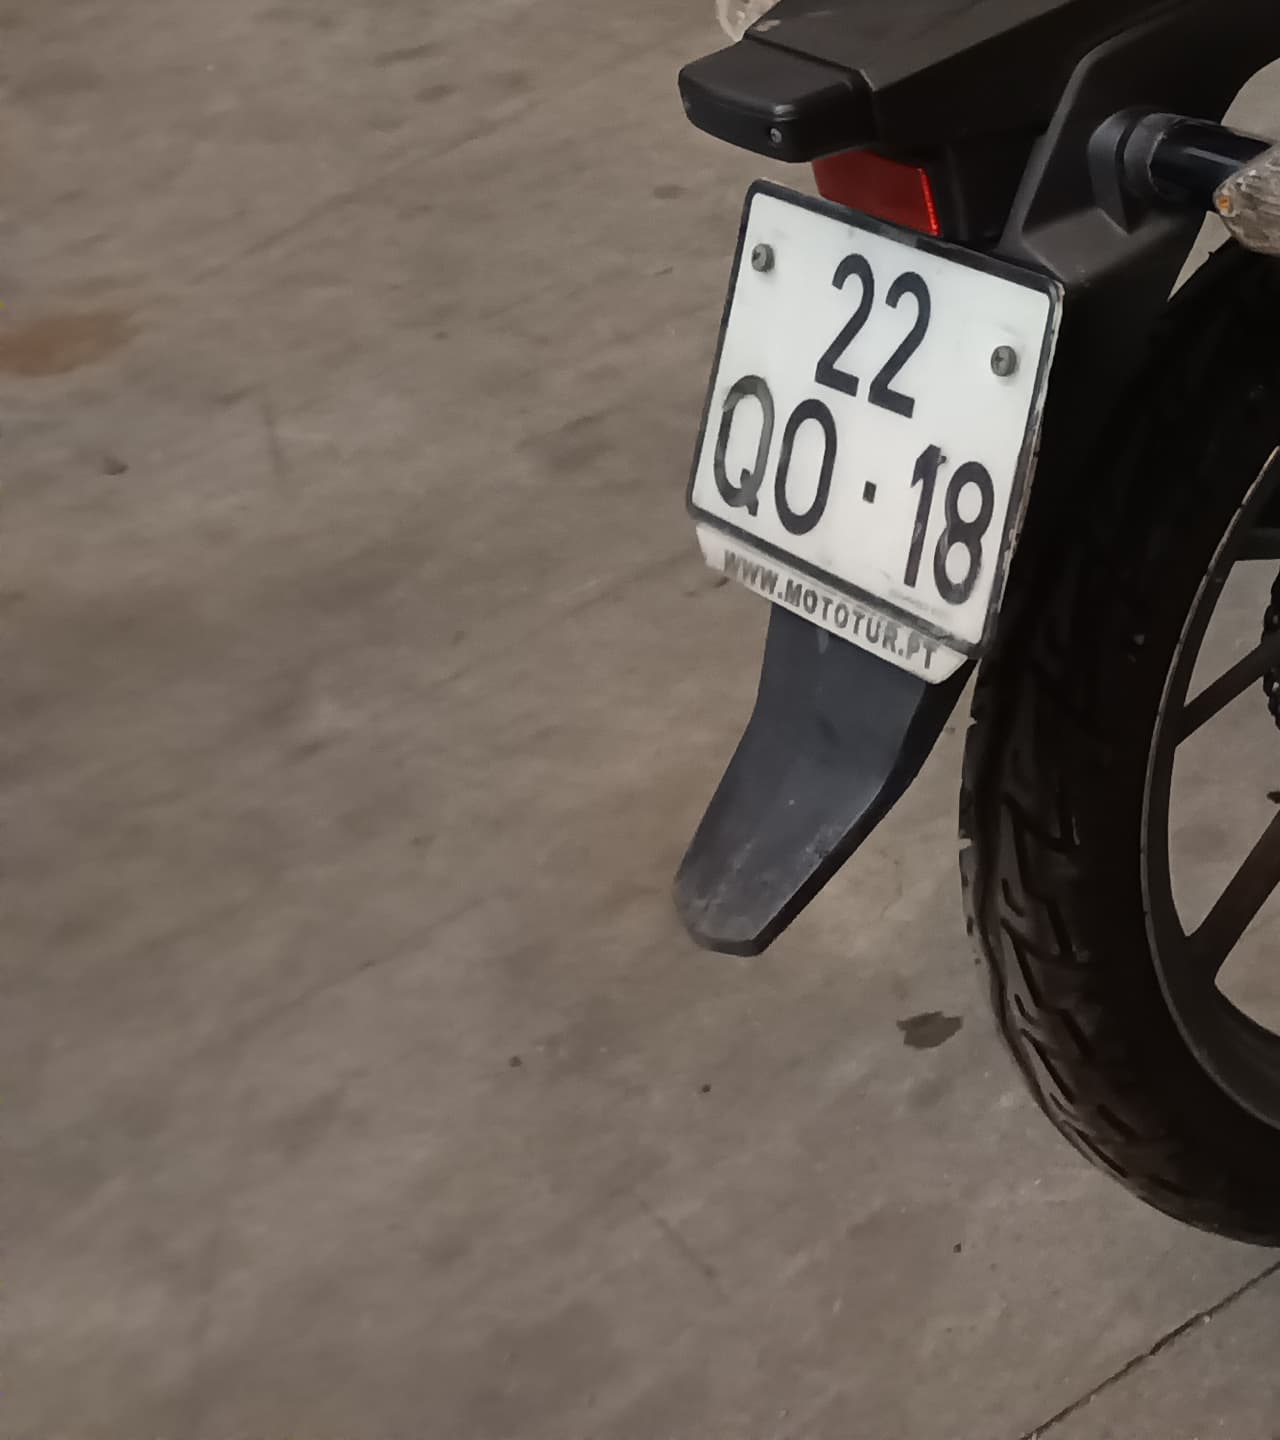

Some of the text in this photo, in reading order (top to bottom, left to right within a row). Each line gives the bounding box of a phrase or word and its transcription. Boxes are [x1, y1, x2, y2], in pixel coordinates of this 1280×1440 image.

[814, 253, 932, 418] 22
[902, 443, 995, 605] 18
[723, 547, 940, 670] WWW.MOTOTUR.PT
